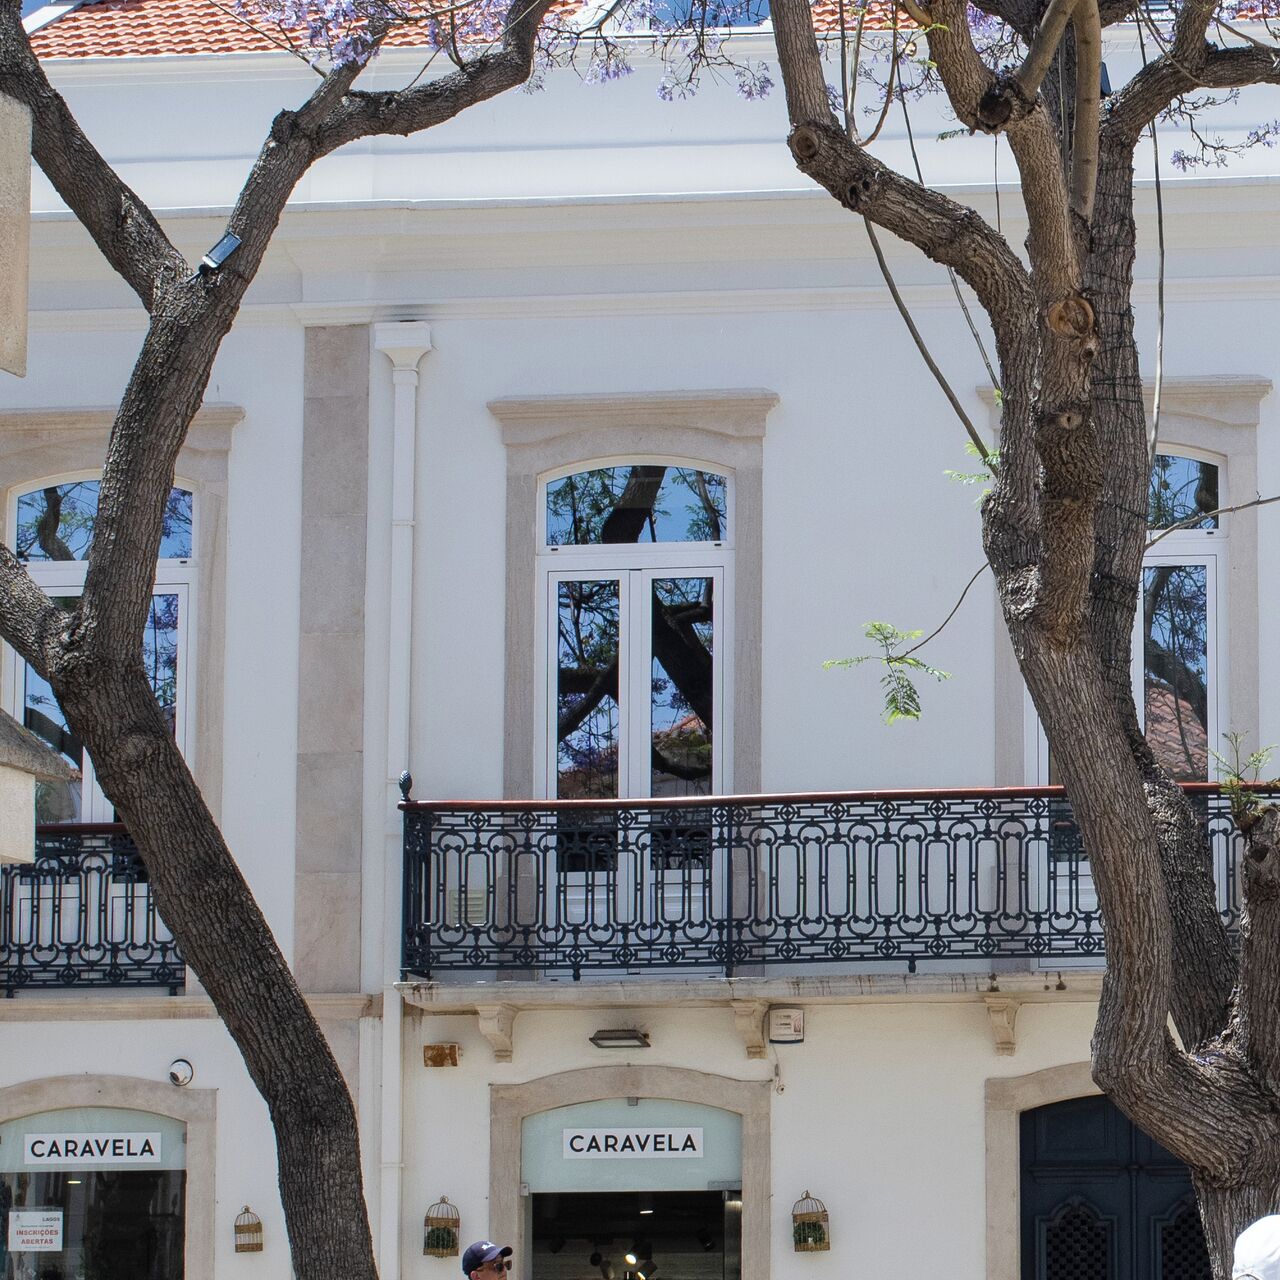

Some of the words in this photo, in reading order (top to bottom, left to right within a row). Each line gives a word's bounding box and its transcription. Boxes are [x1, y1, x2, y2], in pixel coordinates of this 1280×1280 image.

[30, 1139, 155, 1157] CARAVELA
[569, 1134, 697, 1152] CARAVELA
[16, 1228, 59, 1236] INSCRIÇÕES
